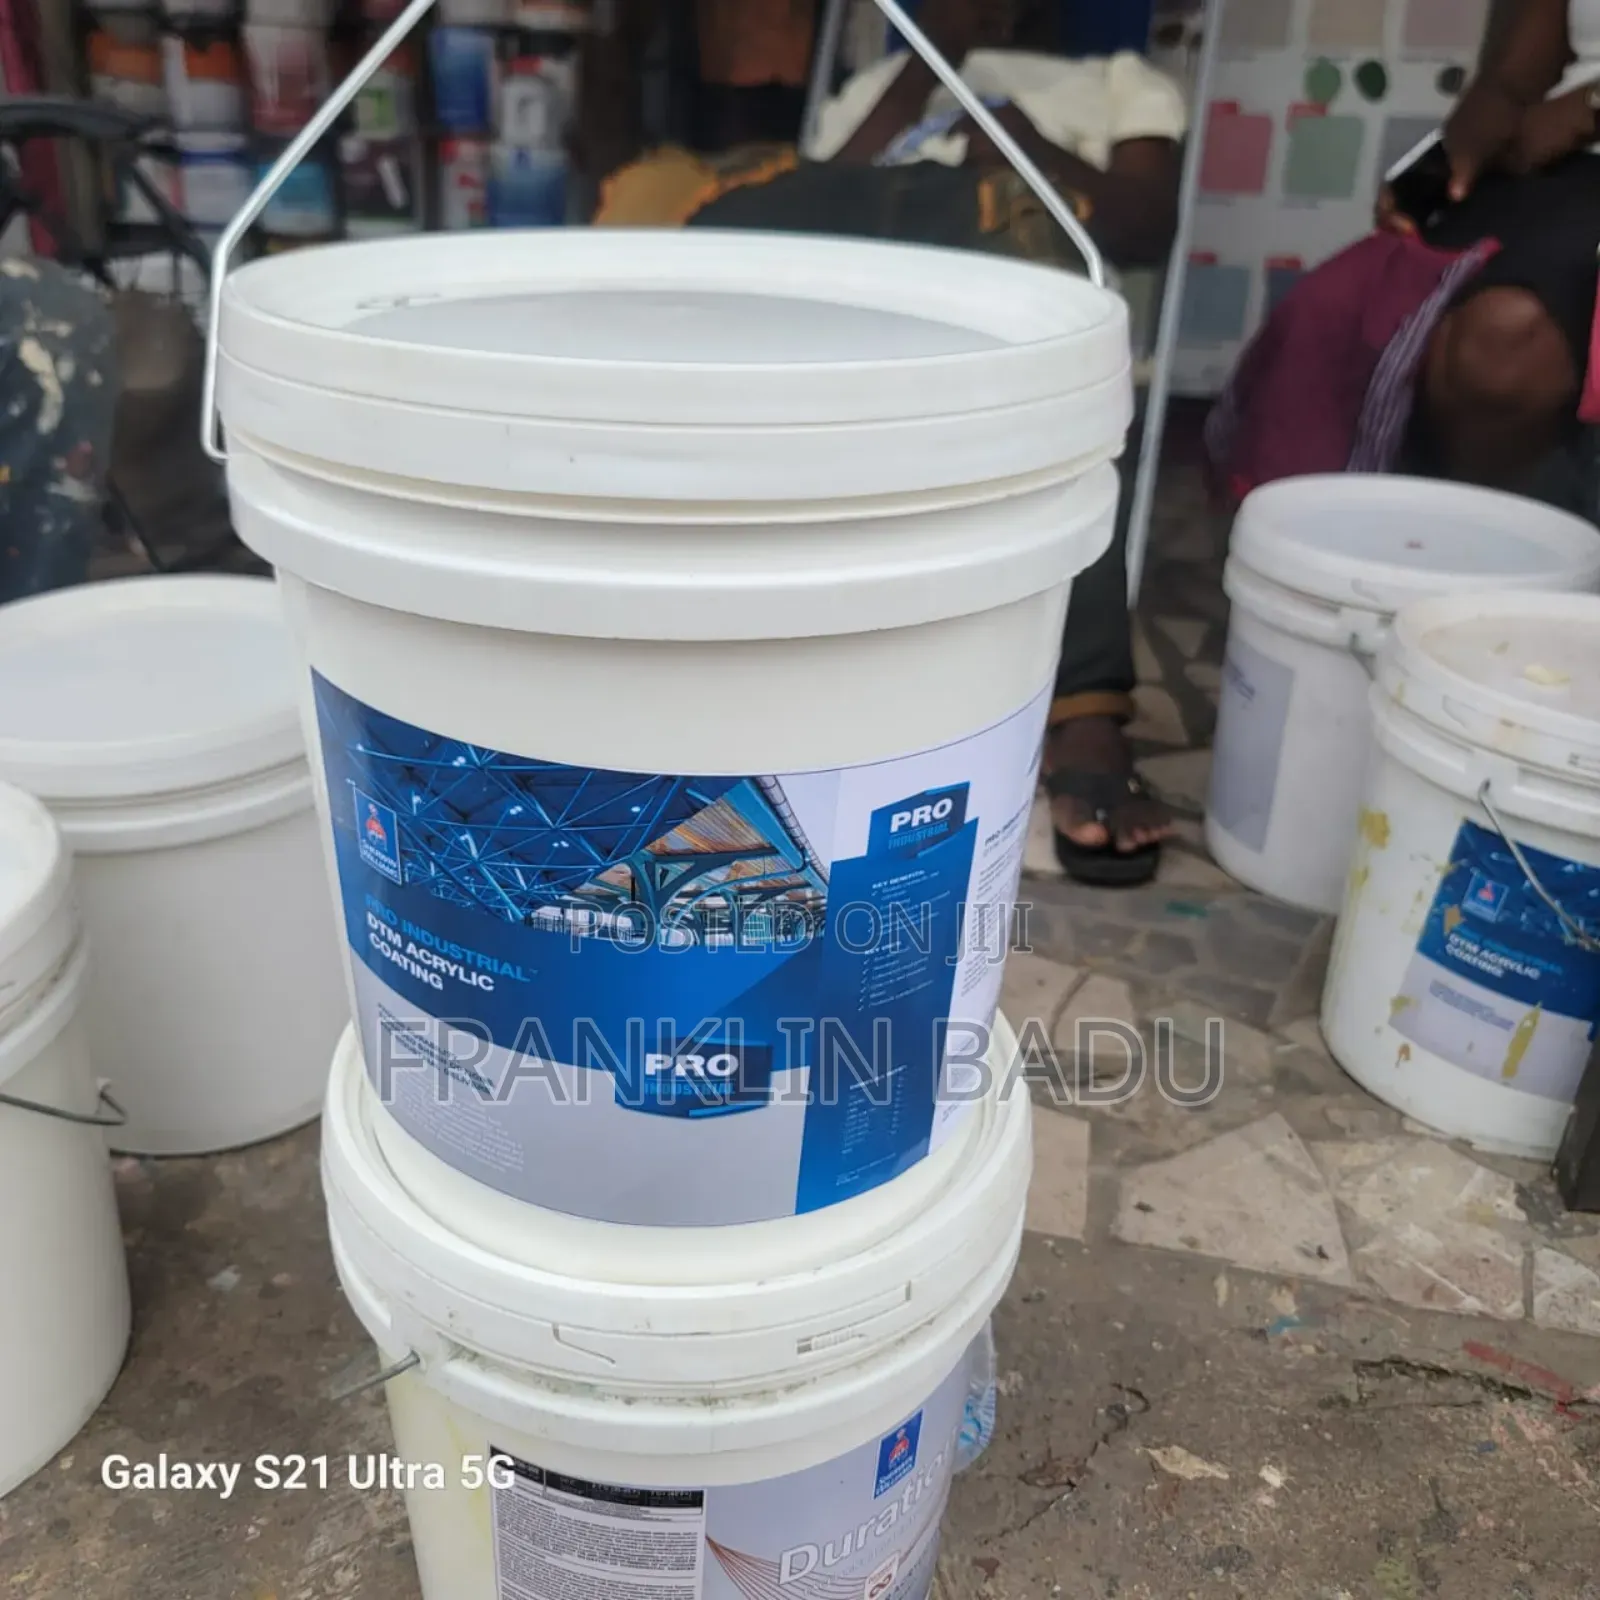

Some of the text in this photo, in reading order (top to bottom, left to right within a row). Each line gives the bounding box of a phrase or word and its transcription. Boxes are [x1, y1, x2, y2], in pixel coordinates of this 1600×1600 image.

[890, 798, 953, 834] PRO
[366, 911, 495, 992] DTM ACRYLIC
[369, 931, 444, 991] COATING
[645, 1053, 739, 1077] PRO
[644, 1082, 736, 1096] INDUSTRIAL
